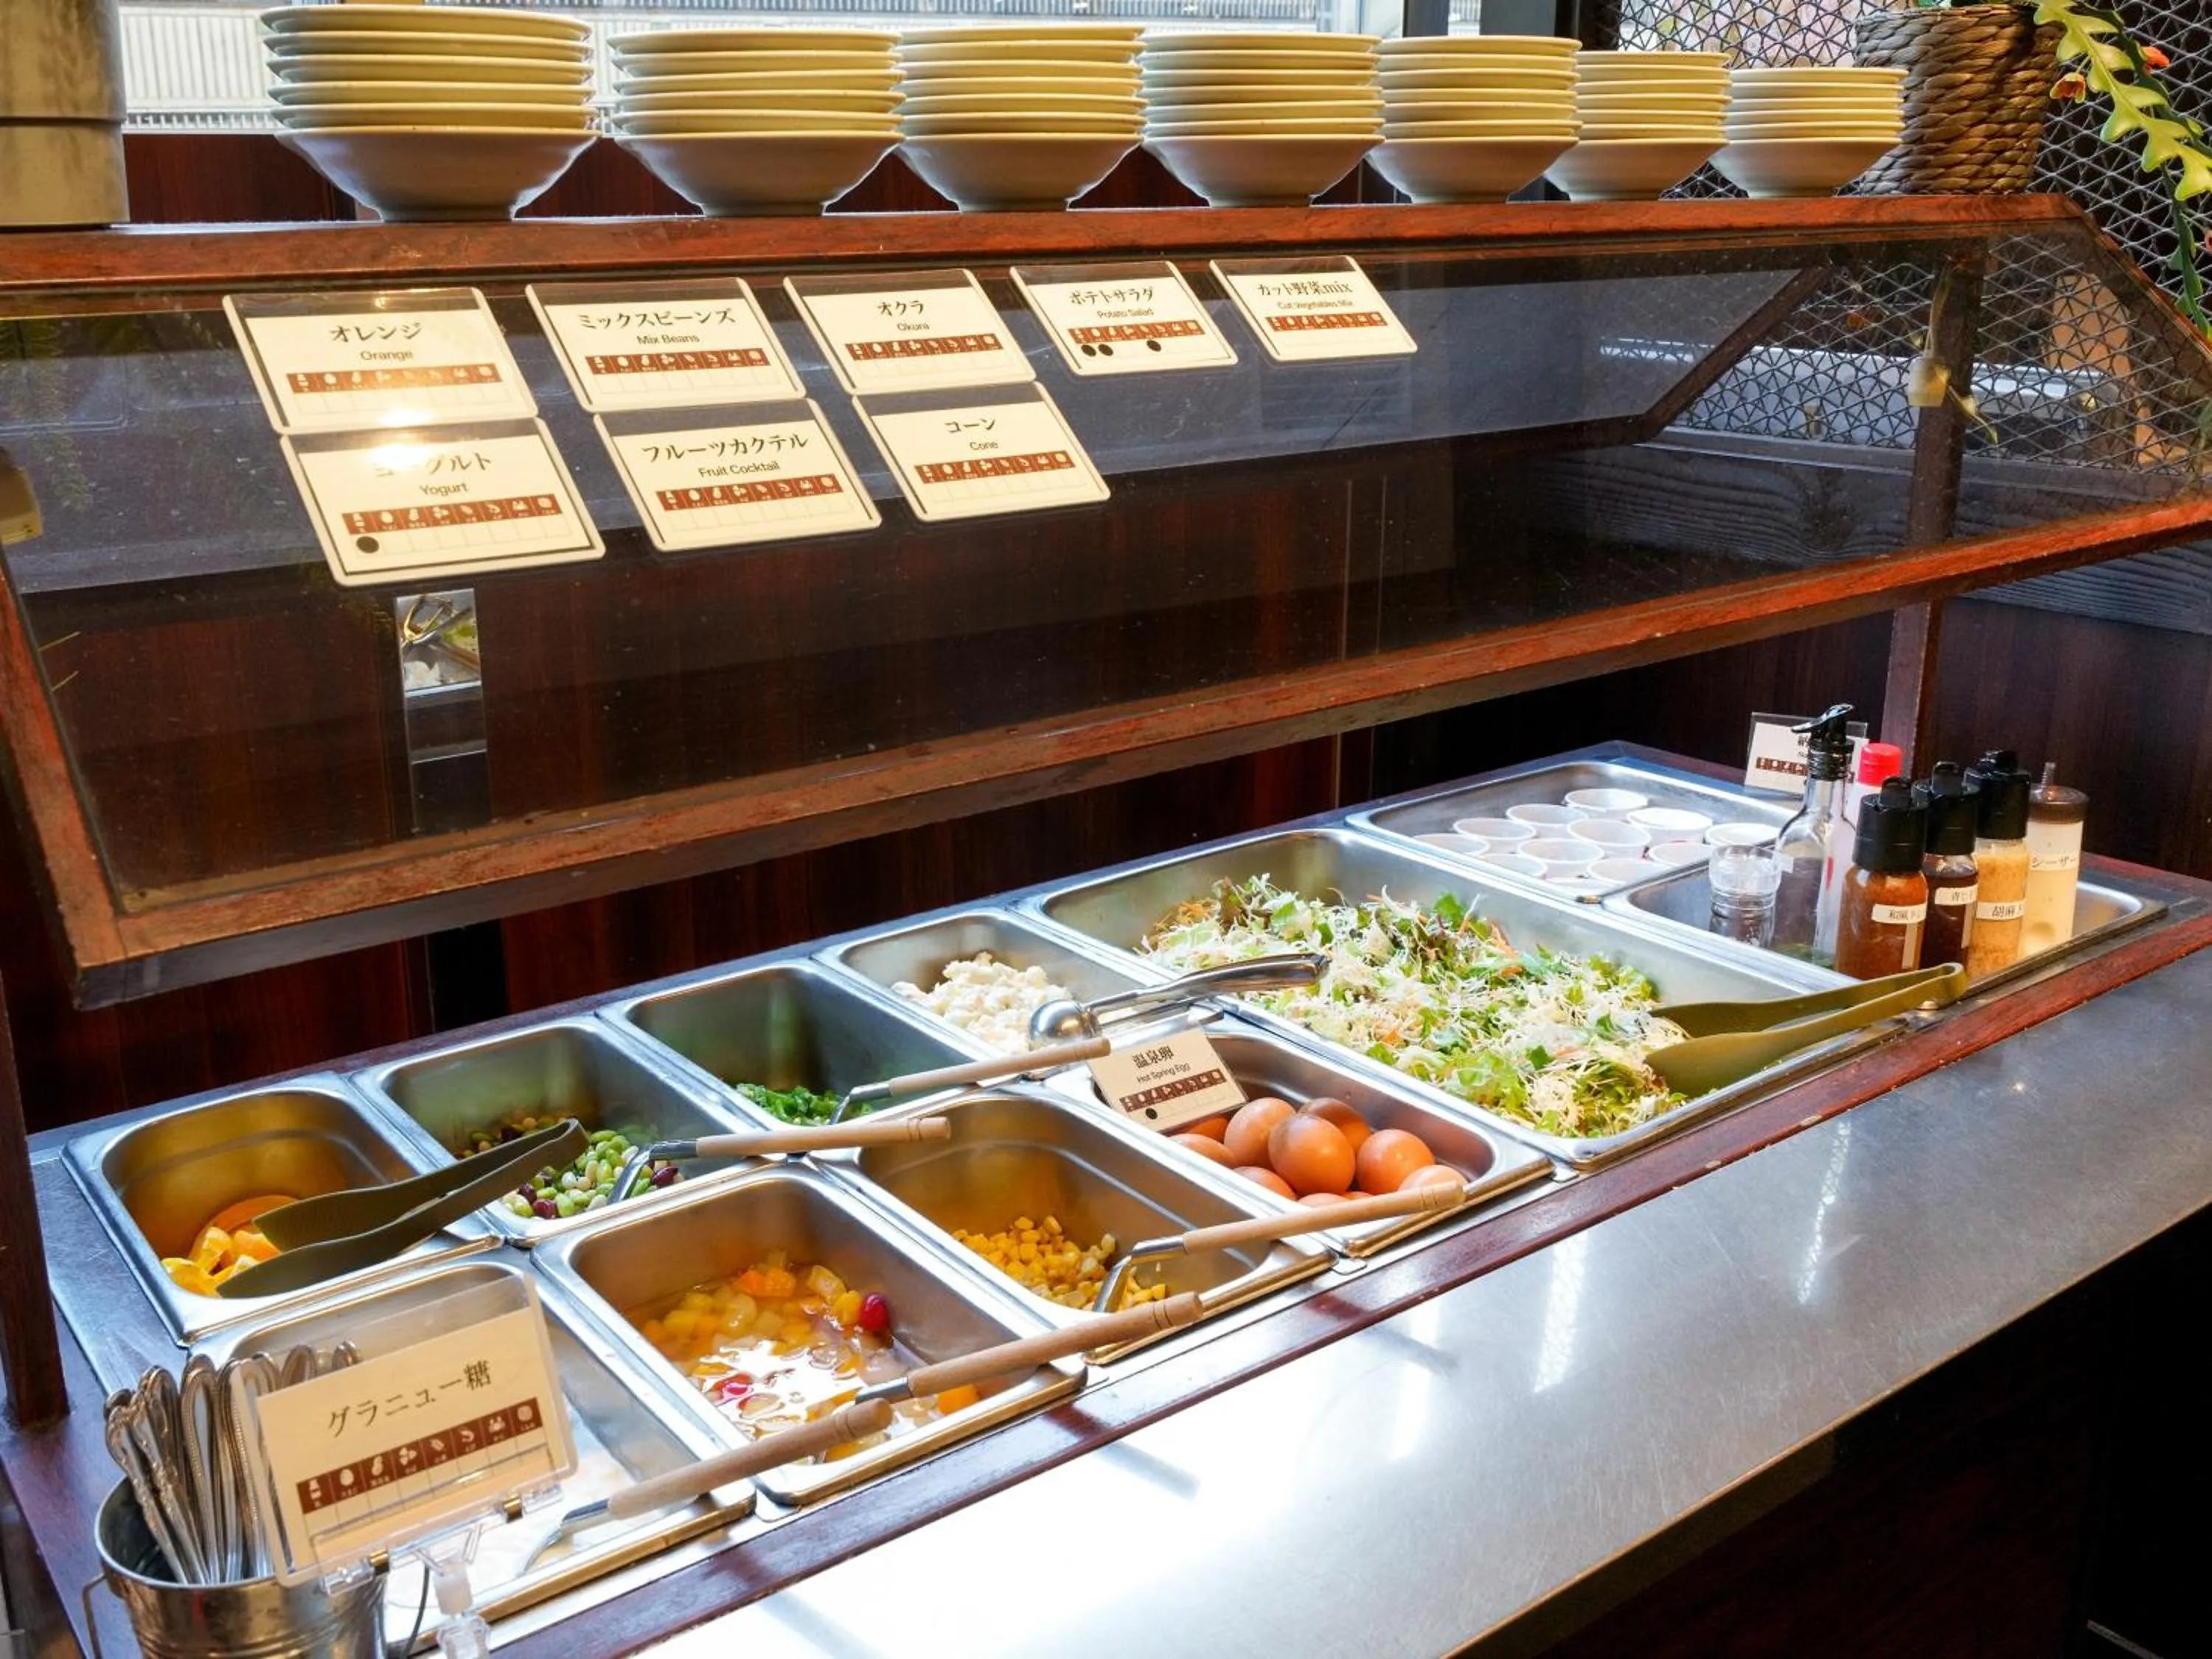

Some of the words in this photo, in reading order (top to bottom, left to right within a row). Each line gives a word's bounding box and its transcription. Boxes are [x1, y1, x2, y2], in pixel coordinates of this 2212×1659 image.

[1069, 285, 1154, 305] ポテトサラダ
[877, 300, 924, 316] オクラ
[579, 307, 737, 329] ミックスビーンズ
[329, 321, 422, 343] オレンジ
[636, 335, 660, 345] Mix
[663, 334, 700, 344] Beans
[360, 350, 414, 361] Orange
[944, 418, 995, 434] コーン
[641, 434, 809, 463] フルーツカクテル
[969, 441, 999, 451] Cone
[698, 465, 728, 478] Fruit
[730, 460, 780, 476] Cocktail
[419, 482, 469, 496] Yogurt
[329, 1360, 492, 1439] グラニュー糖
